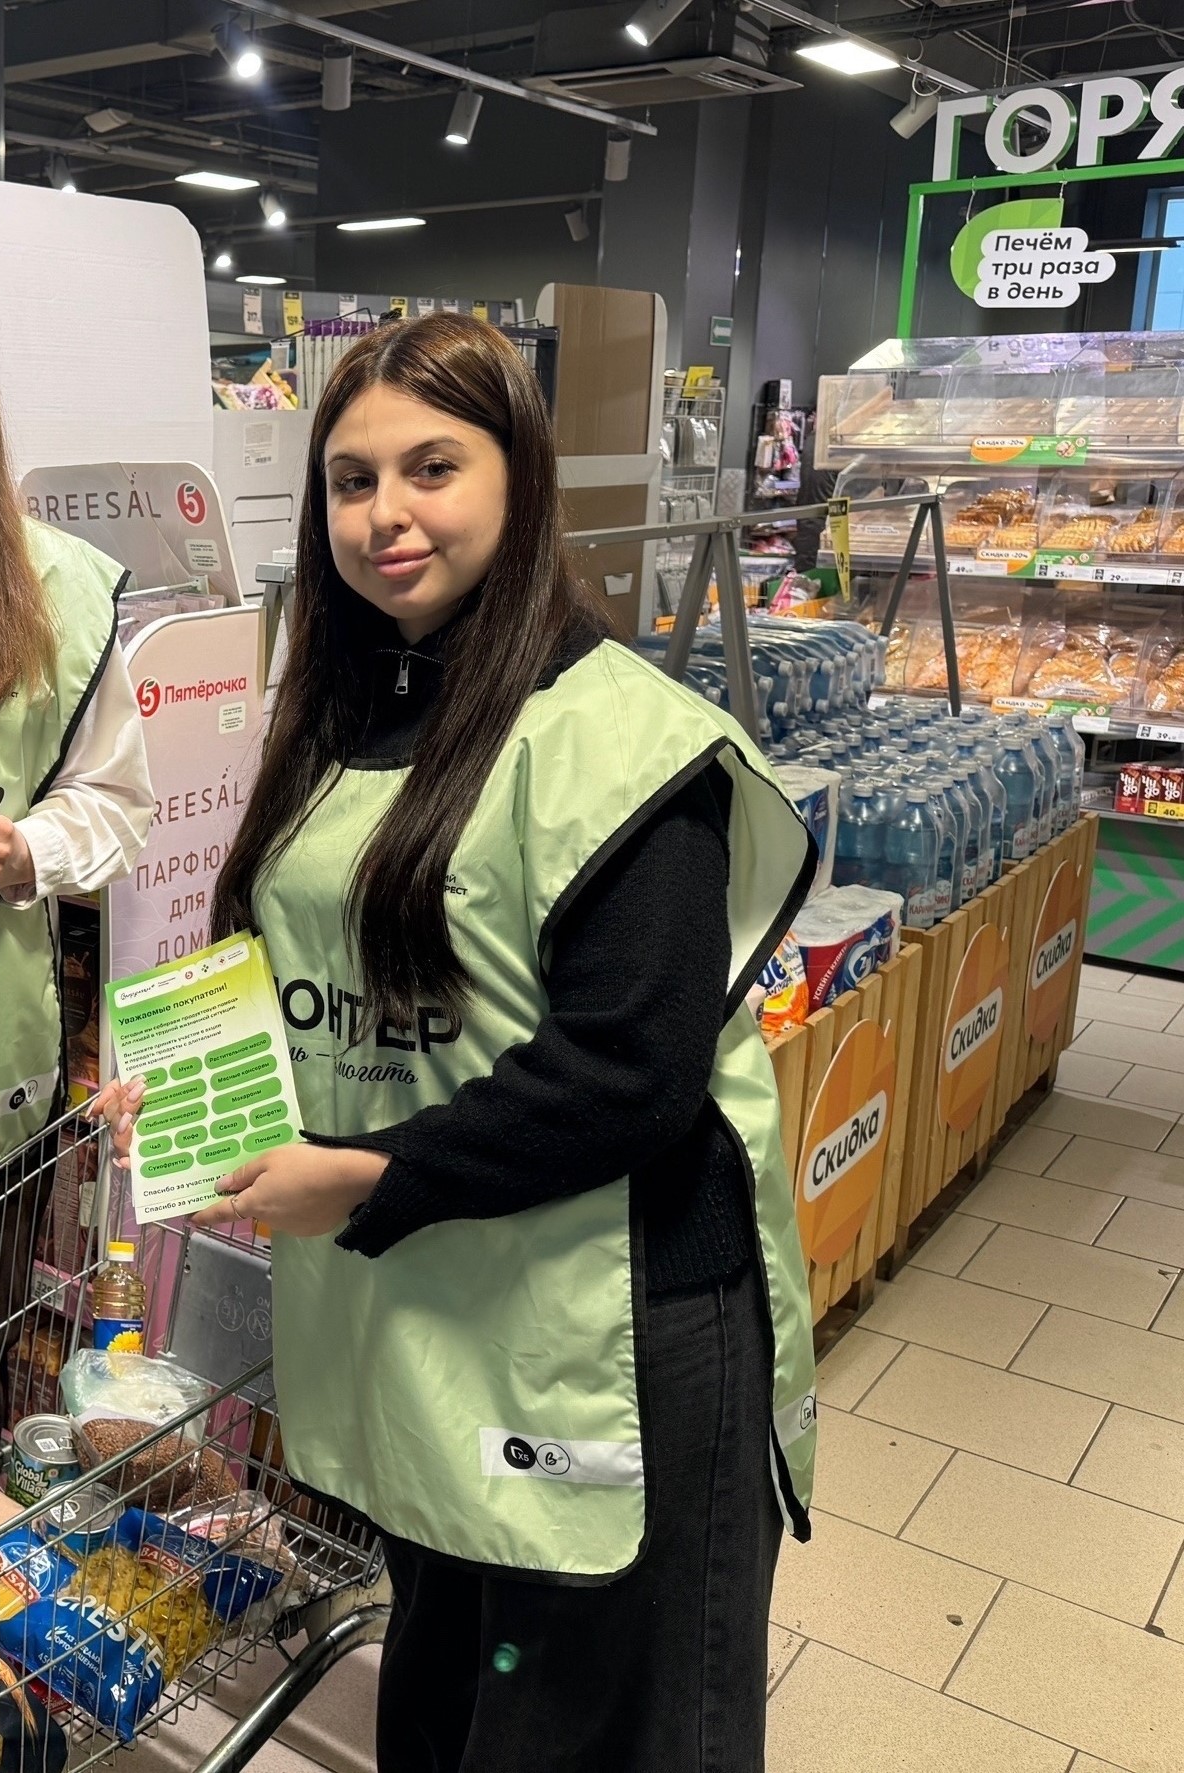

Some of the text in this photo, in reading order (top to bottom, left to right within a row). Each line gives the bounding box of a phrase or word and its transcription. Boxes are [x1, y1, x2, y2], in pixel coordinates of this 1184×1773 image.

[995, 232, 1072, 251] Печём
[991, 260, 1100, 280] три раза
[987, 283, 1064, 299] в день
[164, 676, 247, 704] Пятёрочка
[1163, 809, 1176, 817] 40
[1035, 931, 1072, 979] Скидка
[118, 982, 228, 1026] Уважаемые покупатели!
[950, 1000, 998, 1061] Скидка
[209, 1038, 267, 1063] Растительное масло
[178, 1064, 194, 1073] Мука
[231, 1088, 262, 1103] Макароны
[255, 1107, 282, 1120] Конфеты
[218, 1121, 238, 1131] Сахар
[182, 1132, 199, 1142] Кофе
[254, 1132, 281, 1145] Печенье
[811, 1107, 879, 1186] Скидка
[149, 1143, 161, 1151] Чай
[205, 1146, 231, 1158] Варенье
[148, 1157, 187, 1172] Сухофрукты
[143, 1185, 176, 1197] Спасибо
[186, 1175, 215, 1189] участие
[144, 1201, 176, 1214] Спасибо
[177, 1199, 186, 1207] за
[187, 1192, 217, 1206] участие
[15, 1461, 44, 1487] Global
[15, 1477, 49, 1498] Village
